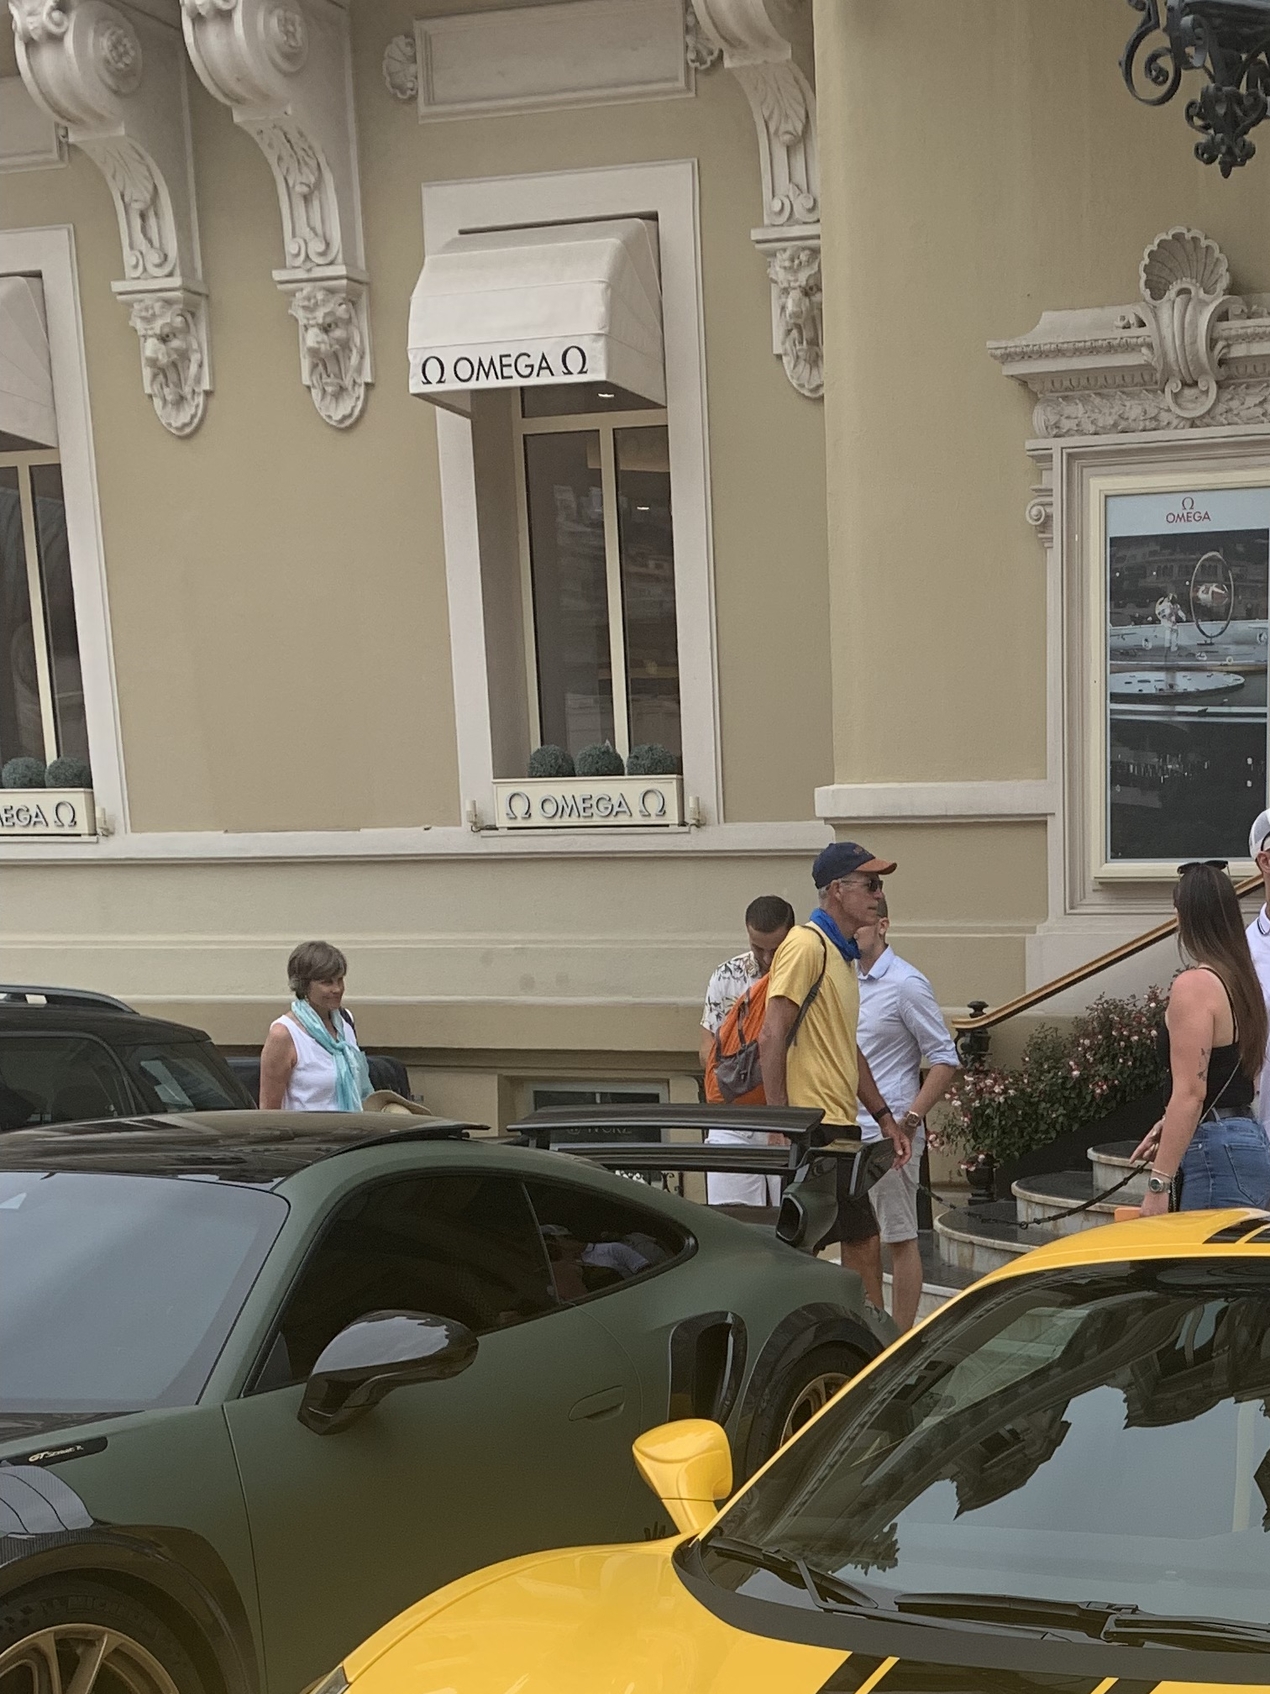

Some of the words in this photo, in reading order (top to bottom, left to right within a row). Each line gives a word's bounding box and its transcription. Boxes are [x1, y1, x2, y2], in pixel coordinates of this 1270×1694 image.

[453, 351, 554, 383] OMEGA
[1165, 510, 1212, 524] OMEGA
[539, 793, 632, 819] OMEGA
